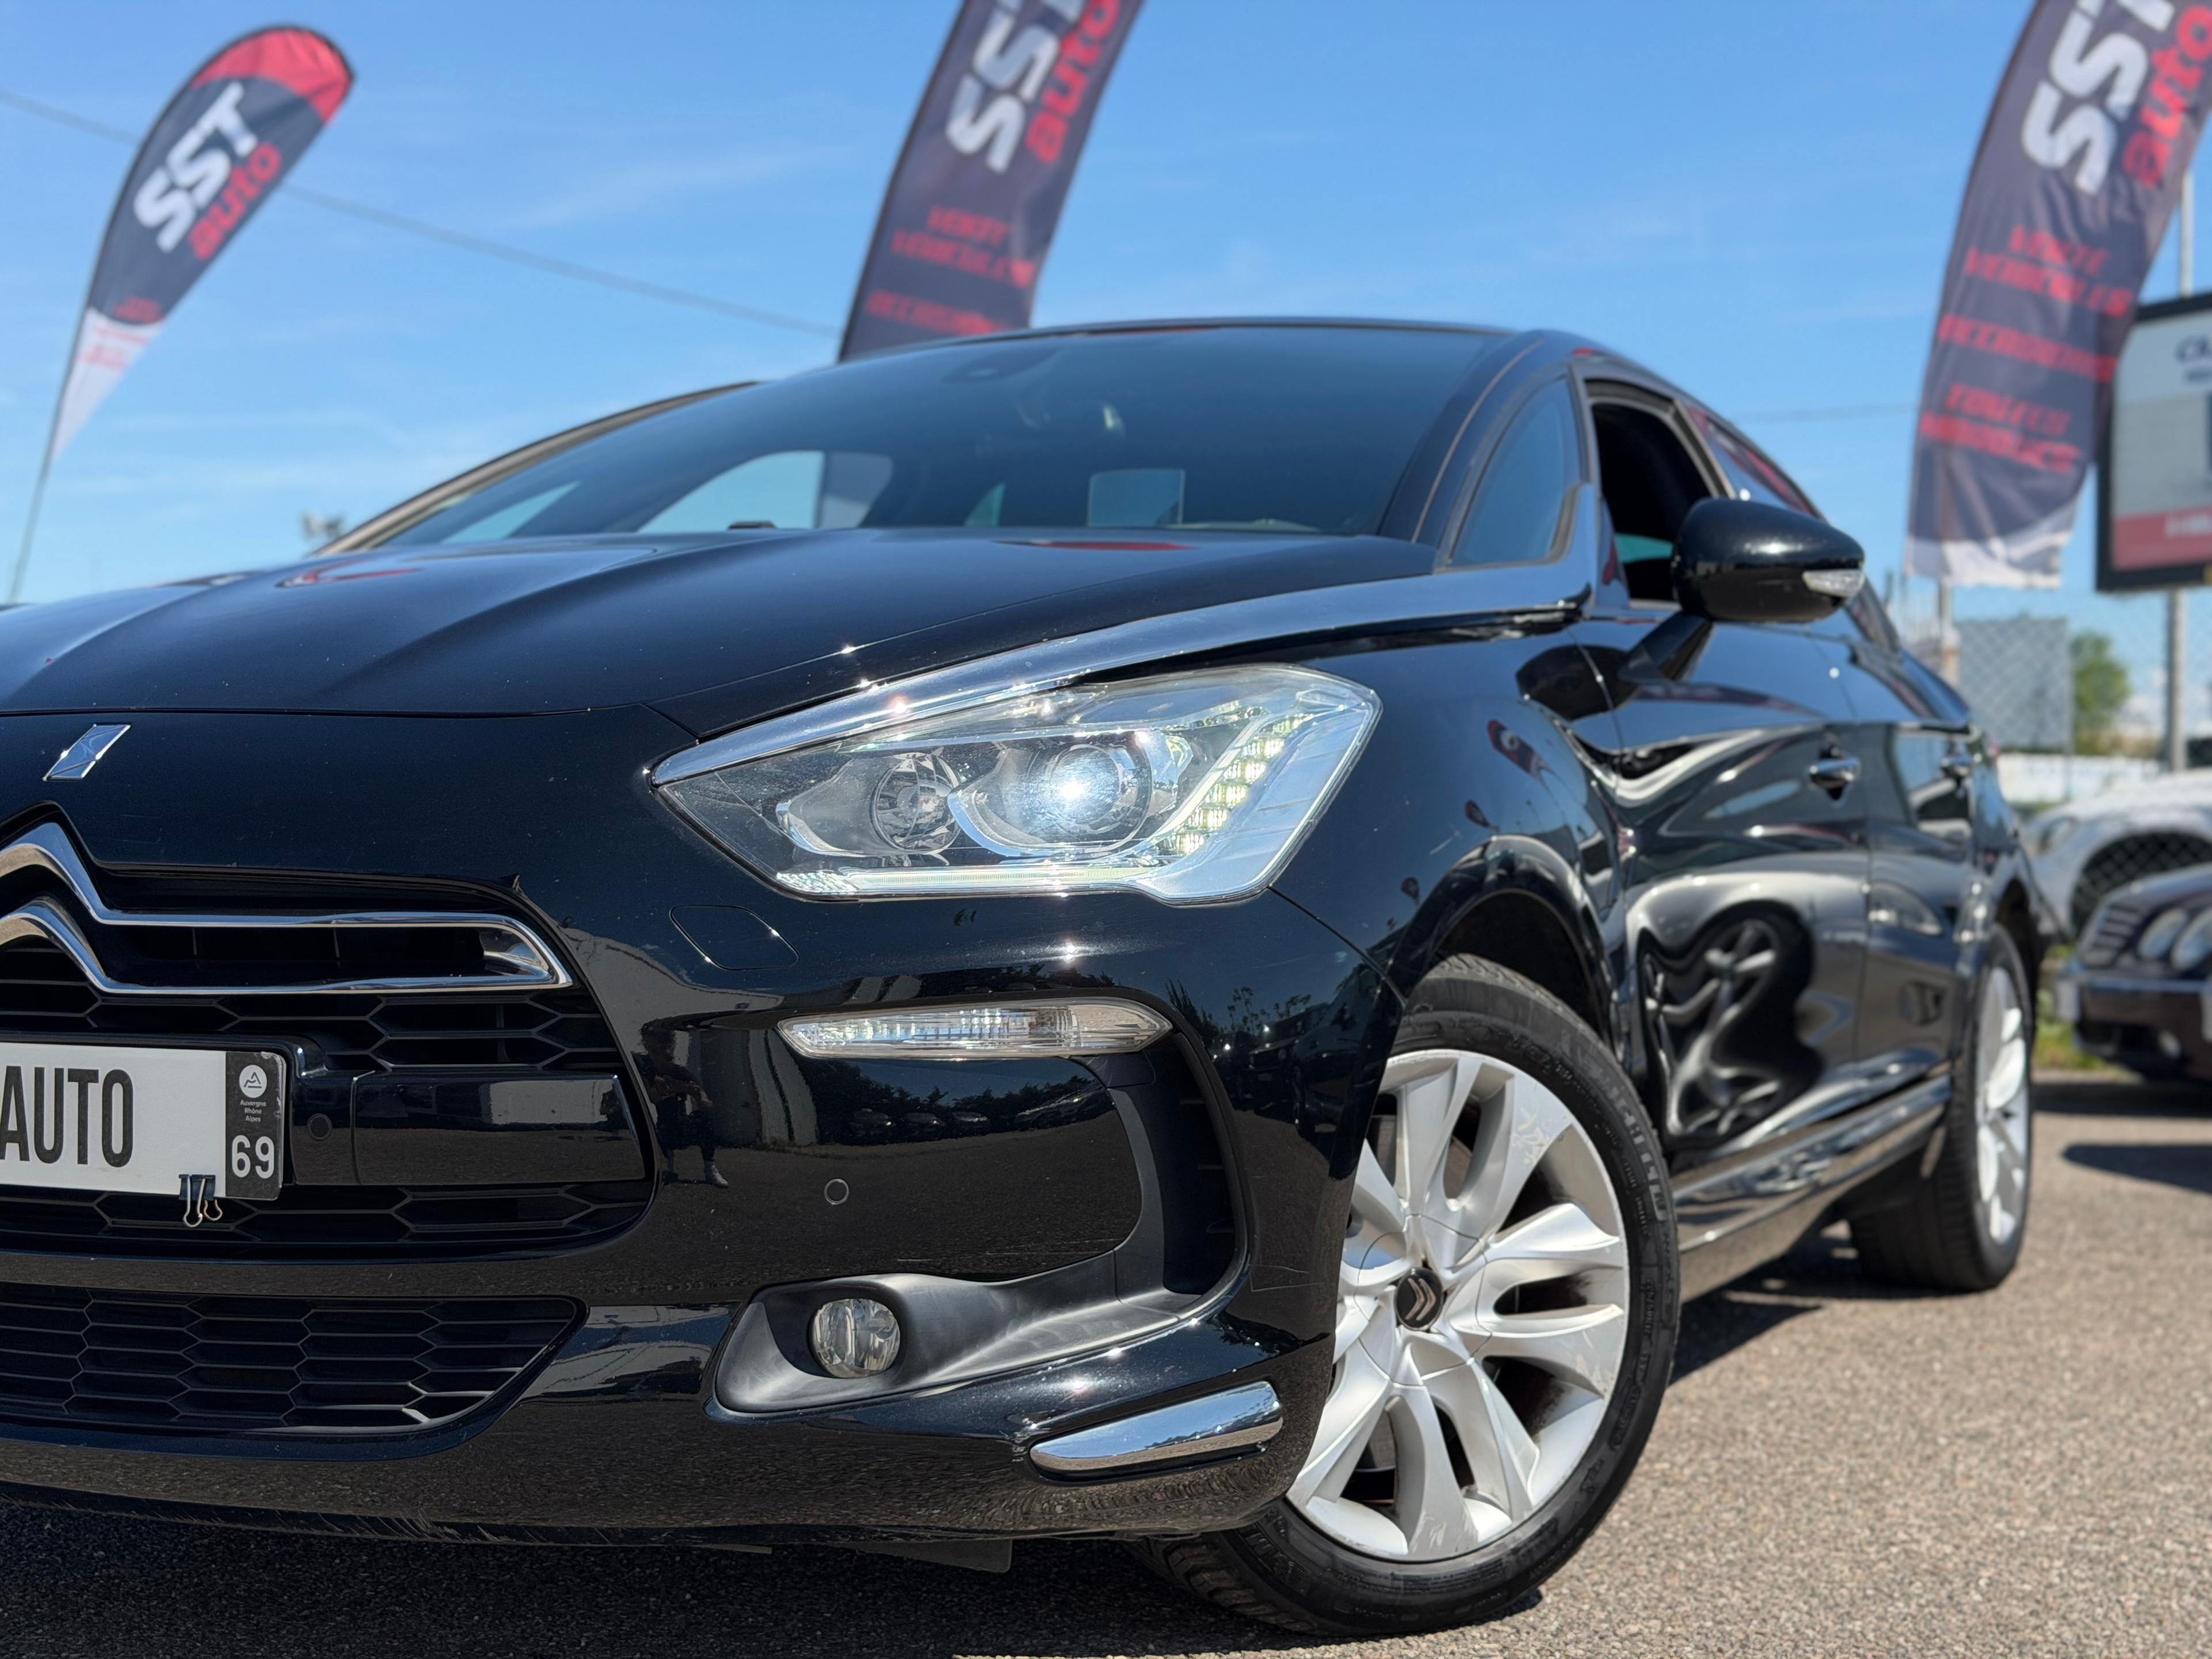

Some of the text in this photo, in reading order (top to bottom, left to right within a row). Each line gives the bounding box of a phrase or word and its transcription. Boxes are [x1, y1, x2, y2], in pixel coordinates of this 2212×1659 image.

[1025, 0, 1120, 165] auto
[2122, 5, 2212, 188] auto
[134, 81, 257, 252] SST
[189, 142, 281, 260] auto
[0, 1065, 134, 1168] AUTO
[232, 1135, 275, 1179] 69
[240, 1099, 267, 1107] Auvergne
